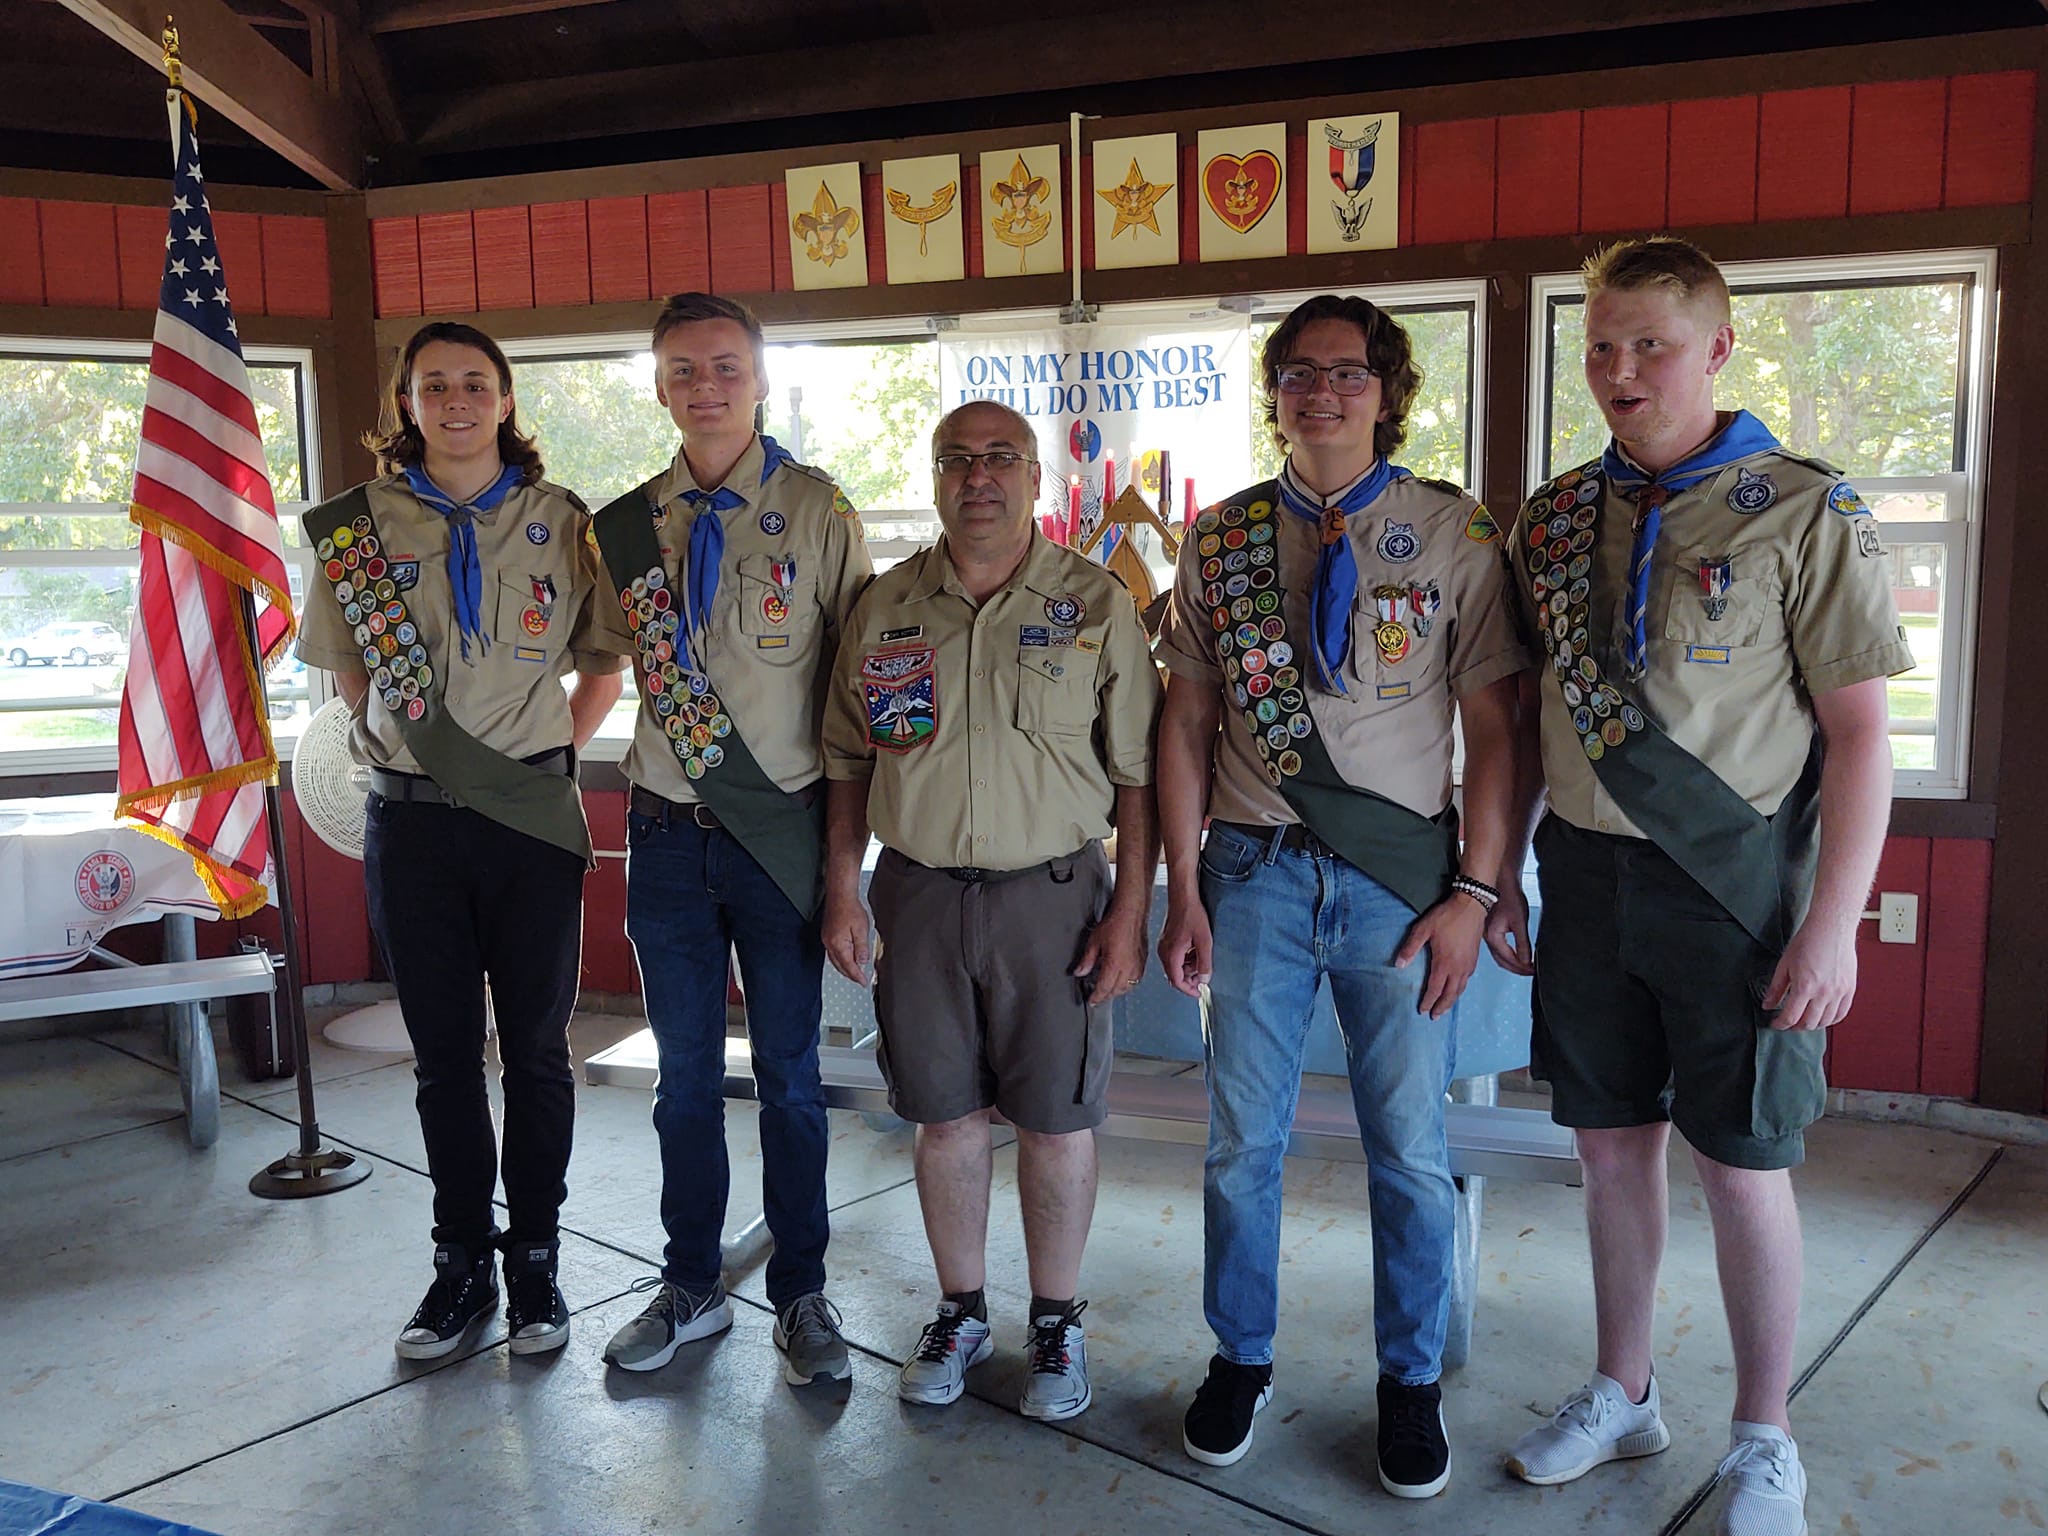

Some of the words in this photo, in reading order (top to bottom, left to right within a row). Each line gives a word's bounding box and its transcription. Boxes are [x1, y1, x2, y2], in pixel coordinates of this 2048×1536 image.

[966, 356, 1011, 386] ON
[1022, 353, 1072, 384] MY
[1080, 344, 1217, 381] HONOR
[1048, 384, 1088, 415] DO
[1097, 382, 1143, 413] MY
[1153, 373, 1227, 409] BEST
[1861, 530, 1880, 553] 25
